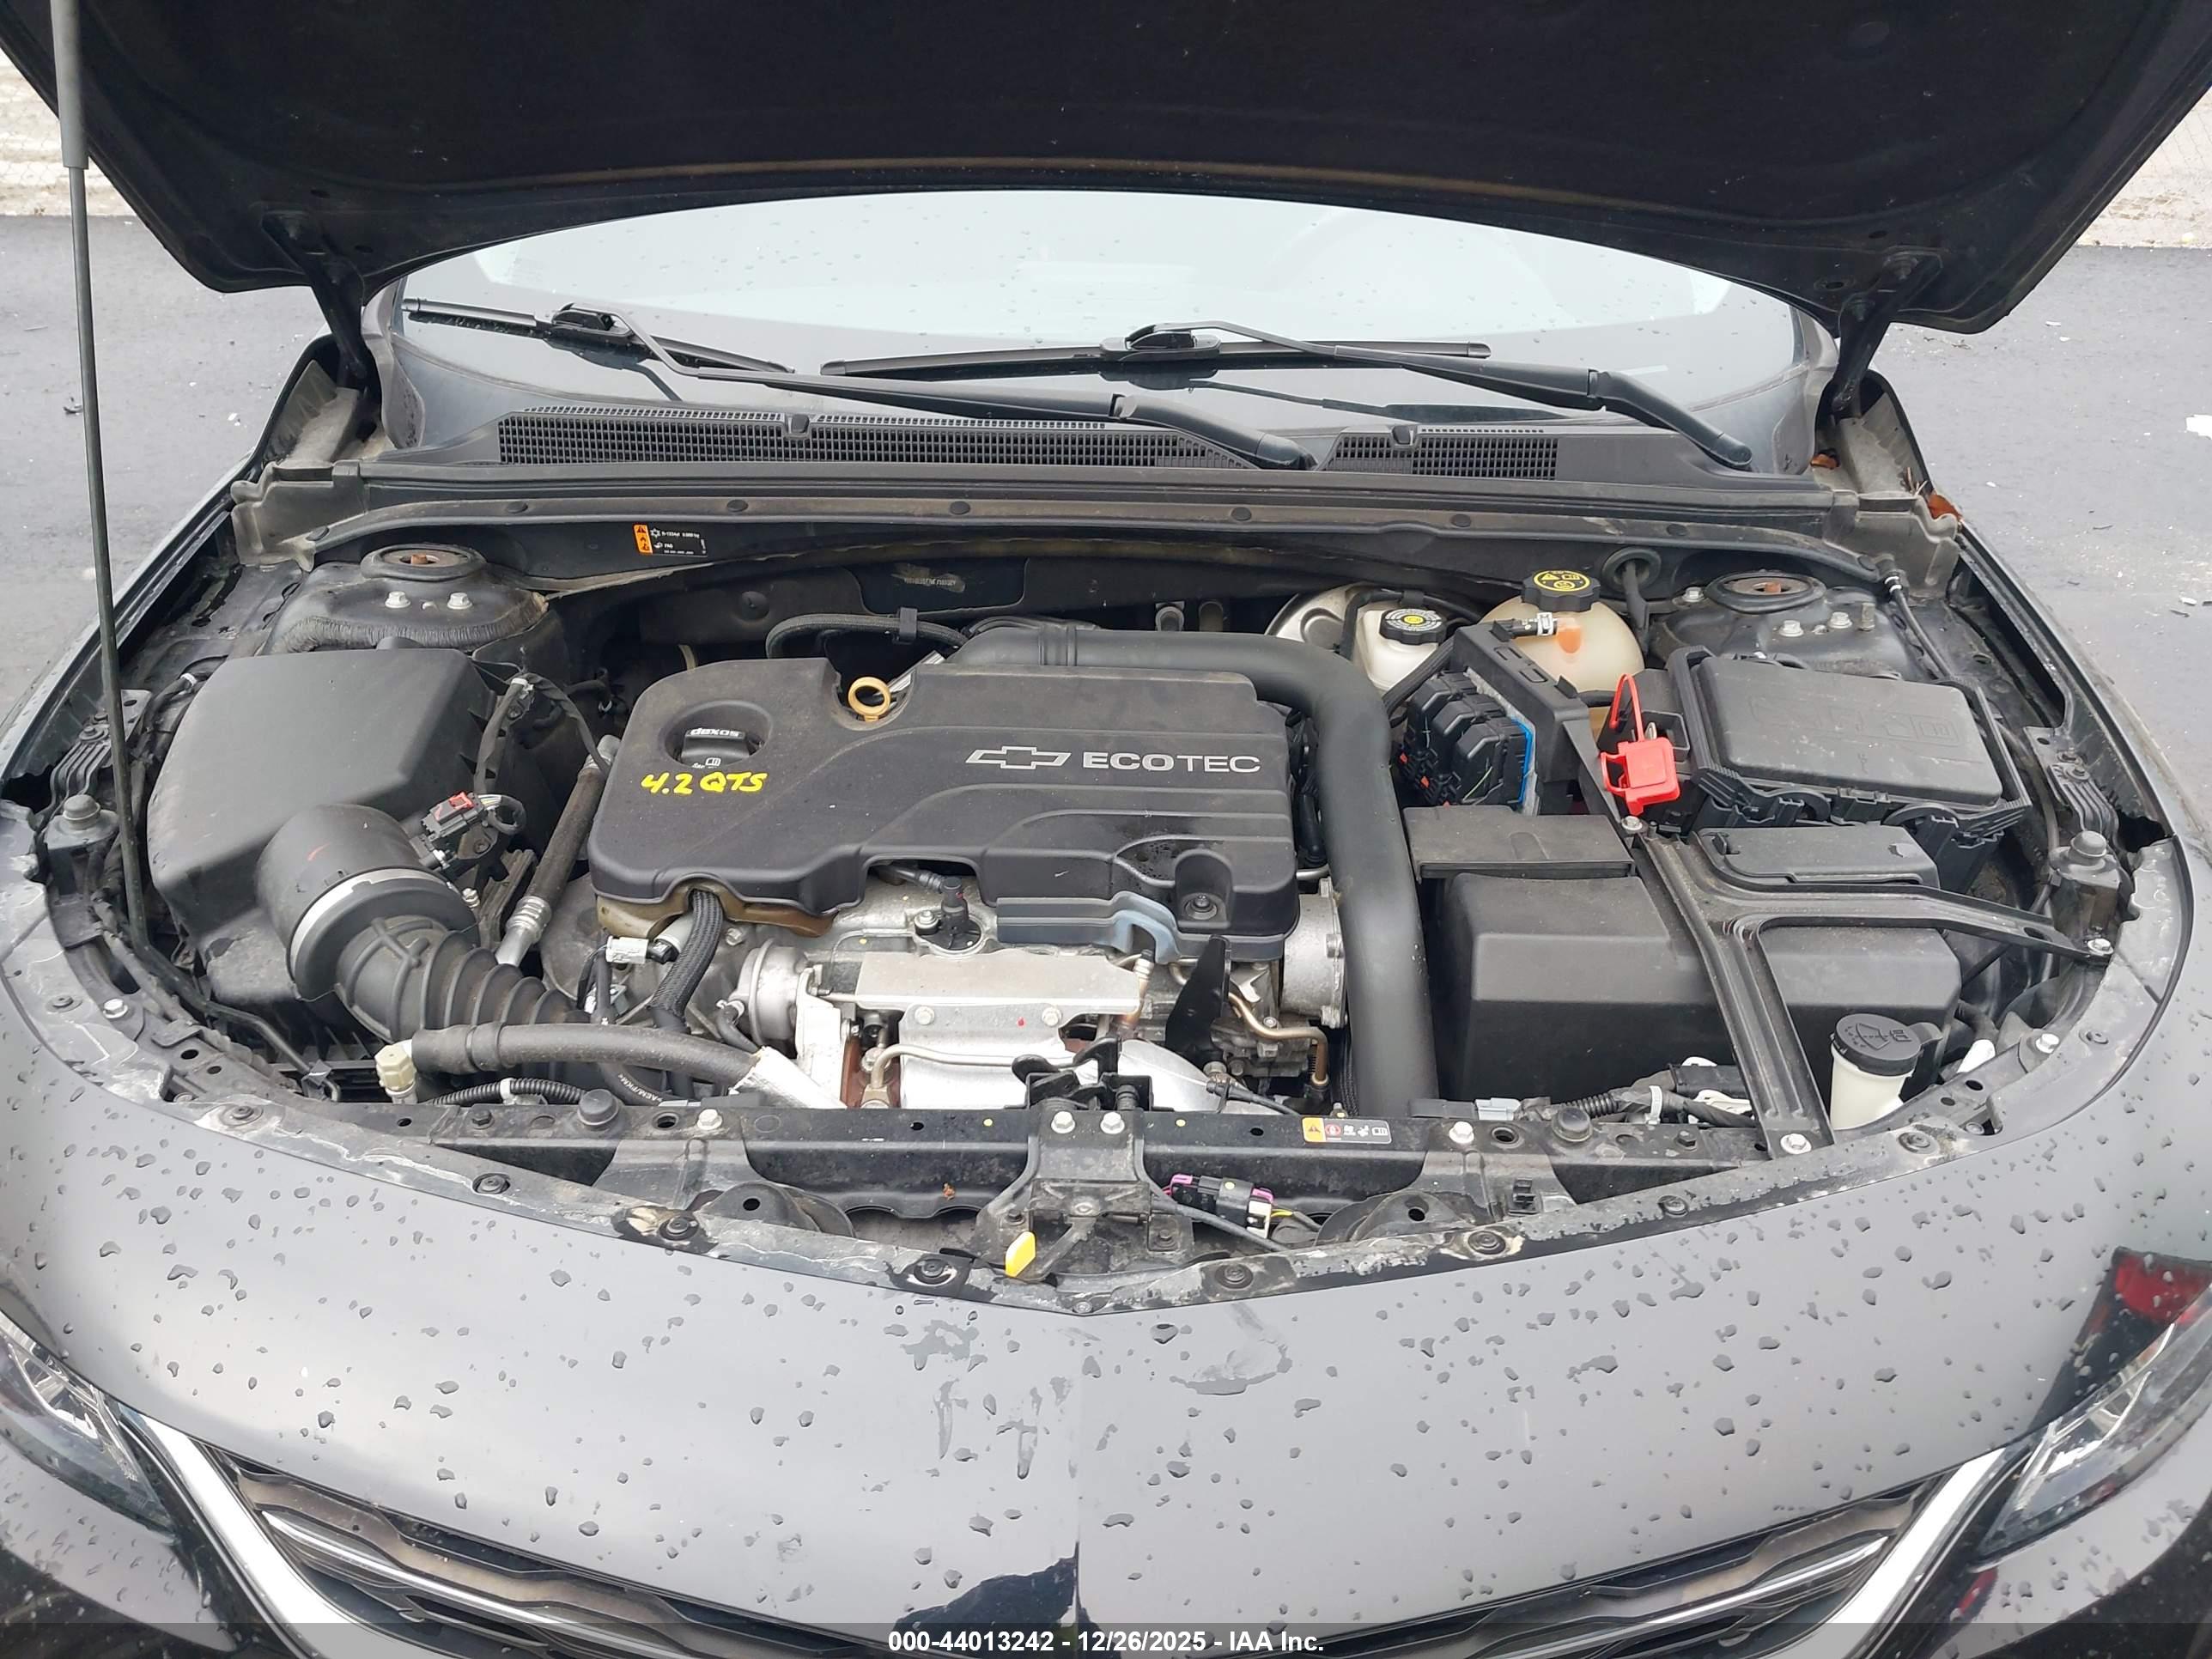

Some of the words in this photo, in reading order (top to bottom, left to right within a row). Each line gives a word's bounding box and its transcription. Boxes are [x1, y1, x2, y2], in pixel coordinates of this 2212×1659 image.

[690, 728, 740, 738] dexos
[1083, 751, 1261, 773] ECOTEC
[641, 772, 694, 795] 4.2
[699, 771, 769, 793] QTS
